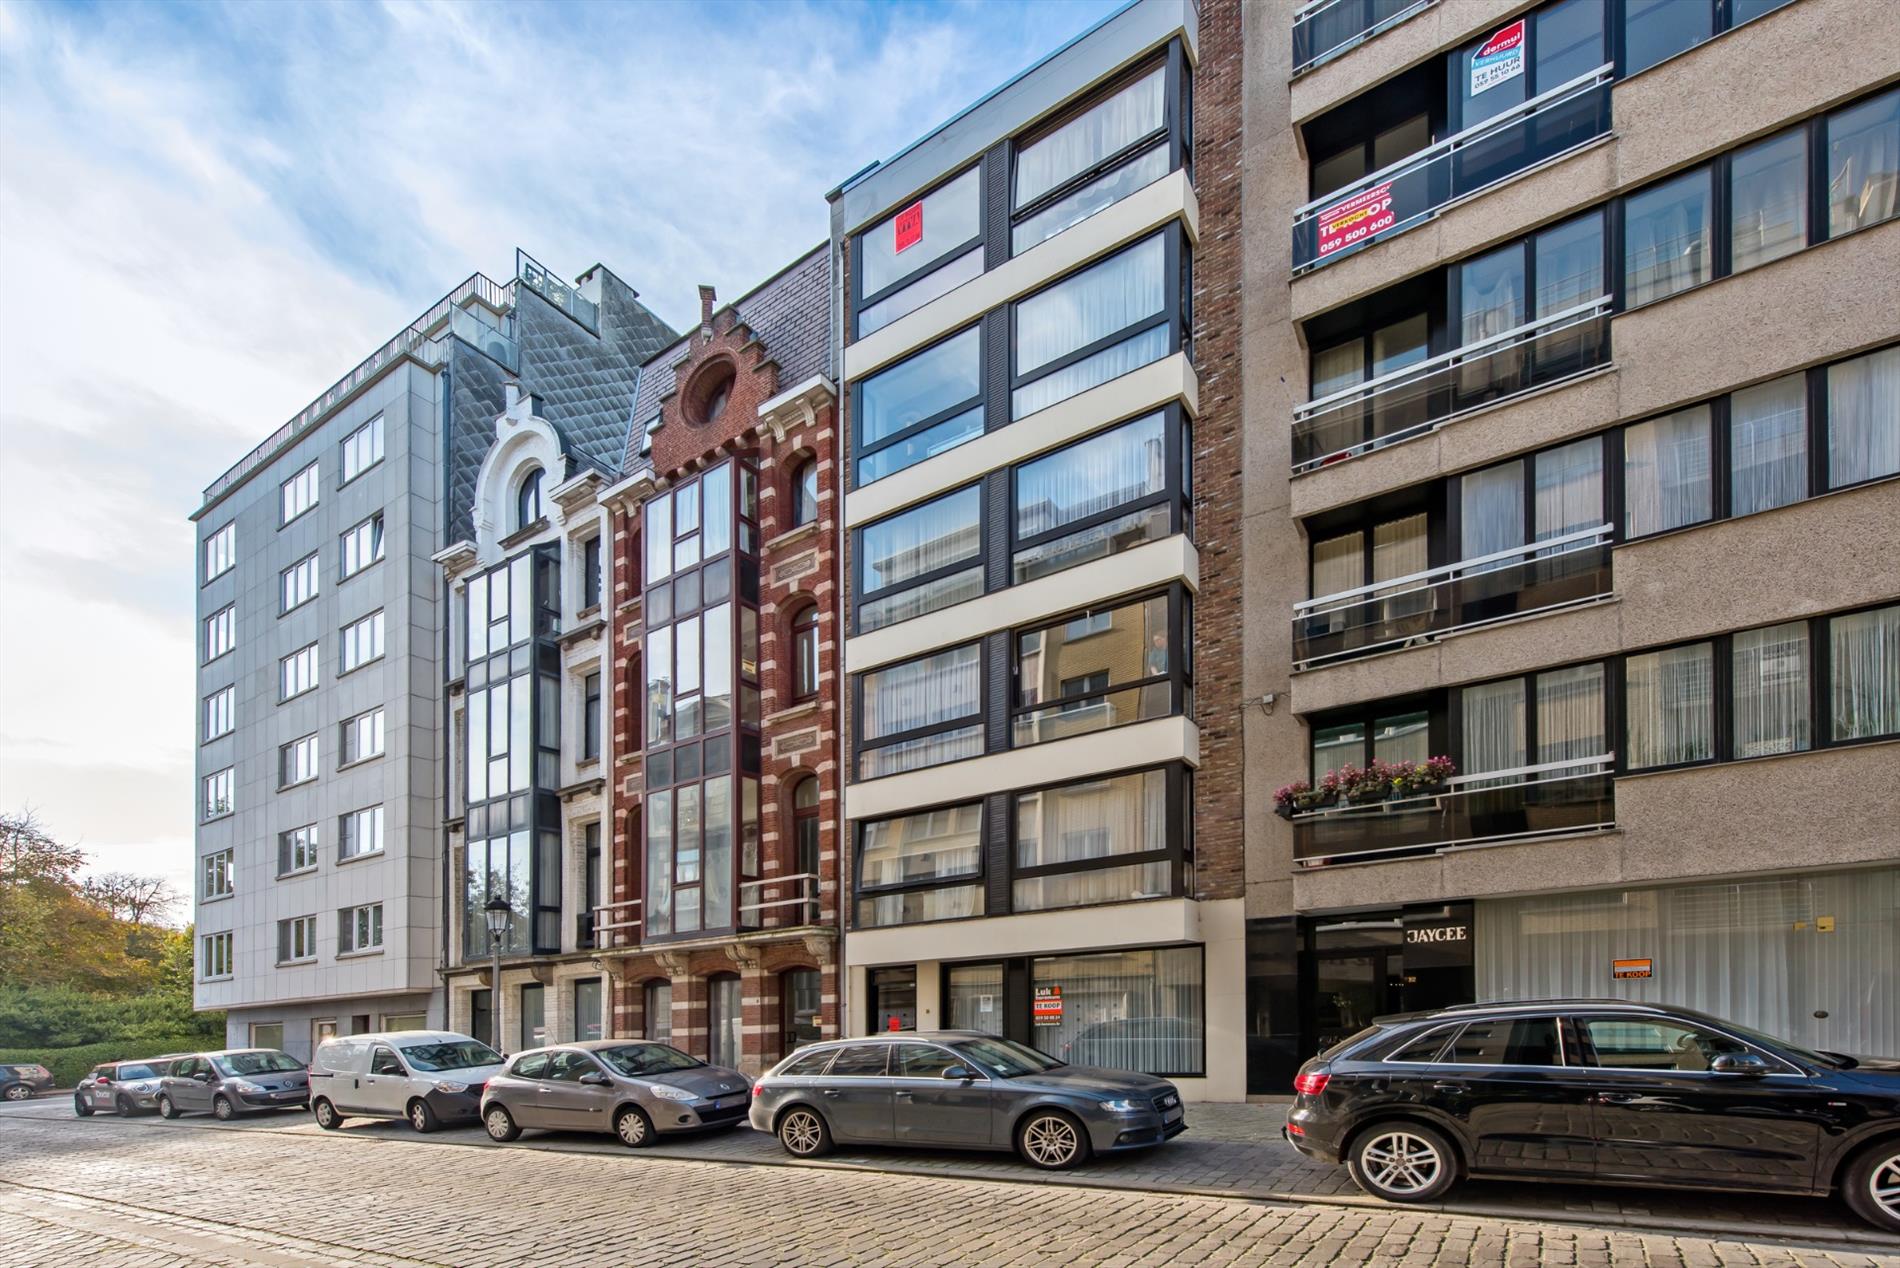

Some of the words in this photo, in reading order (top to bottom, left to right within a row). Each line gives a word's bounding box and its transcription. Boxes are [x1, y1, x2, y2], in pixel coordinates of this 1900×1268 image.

[1483, 32, 1520, 56] dermul
[1475, 49, 1519, 67] VERHUURD
[1474, 71, 1487, 82] TE
[1490, 57, 1520, 76] HUUR
[1332, 209, 1368, 229] VERKOCHT
[1320, 237, 1342, 253] 059
[1345, 227, 1367, 243] 500
[1370, 215, 1392, 231] 600
[1406, 926, 1466, 943] JAYCEE
[1035, 987, 1051, 996] Luk
